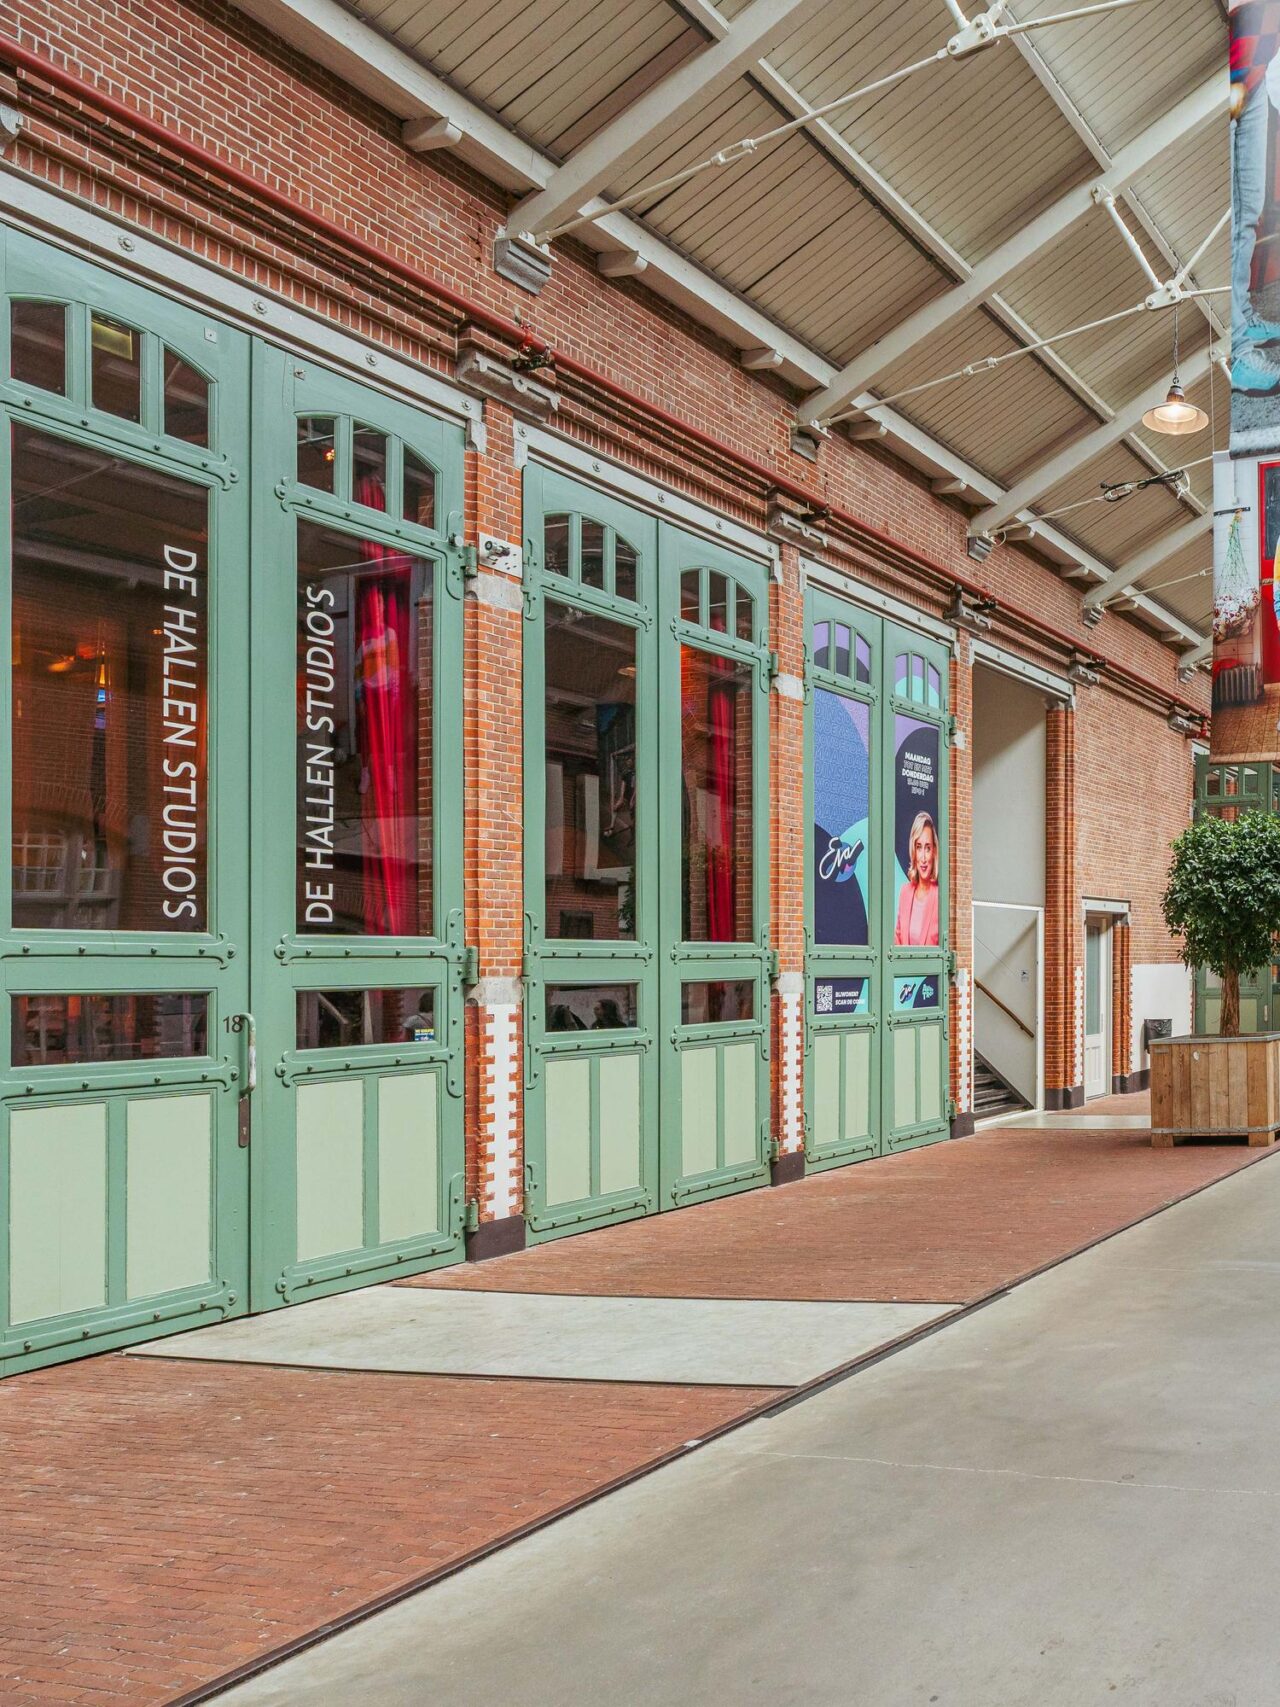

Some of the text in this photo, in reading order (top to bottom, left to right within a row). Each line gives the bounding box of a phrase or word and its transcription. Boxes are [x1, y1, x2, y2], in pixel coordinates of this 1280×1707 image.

[162, 543, 198, 919] DE HALLEN STUDIO'S
[305, 585, 335, 923] DE HALLEN STUDIO'S
[223, 1014, 243, 1033] 18
